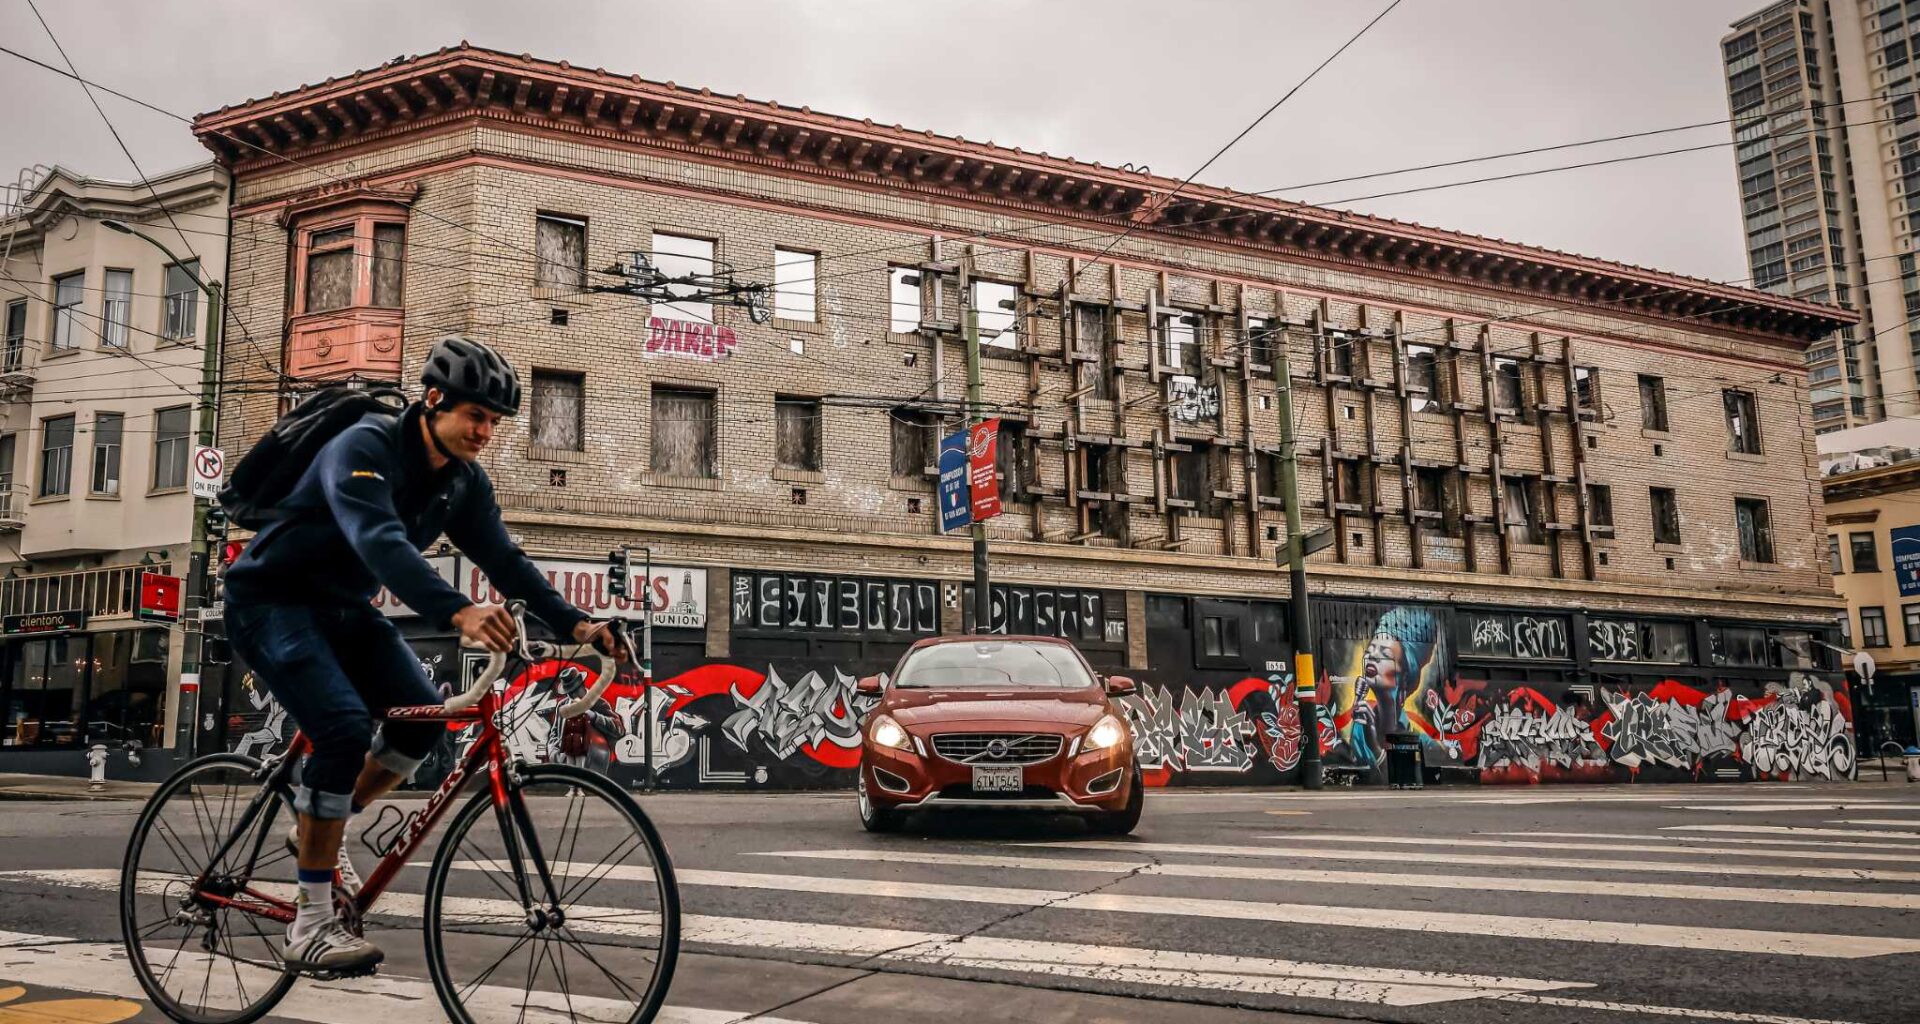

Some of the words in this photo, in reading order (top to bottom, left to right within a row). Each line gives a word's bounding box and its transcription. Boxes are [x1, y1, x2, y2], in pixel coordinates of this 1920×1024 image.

[194, 481, 206, 491] ON
[207, 482, 221, 494] RED
[205, 609, 224, 618] COLUM
[19, 615, 65, 627] cilentano
[658, 614, 699, 625] UNION
